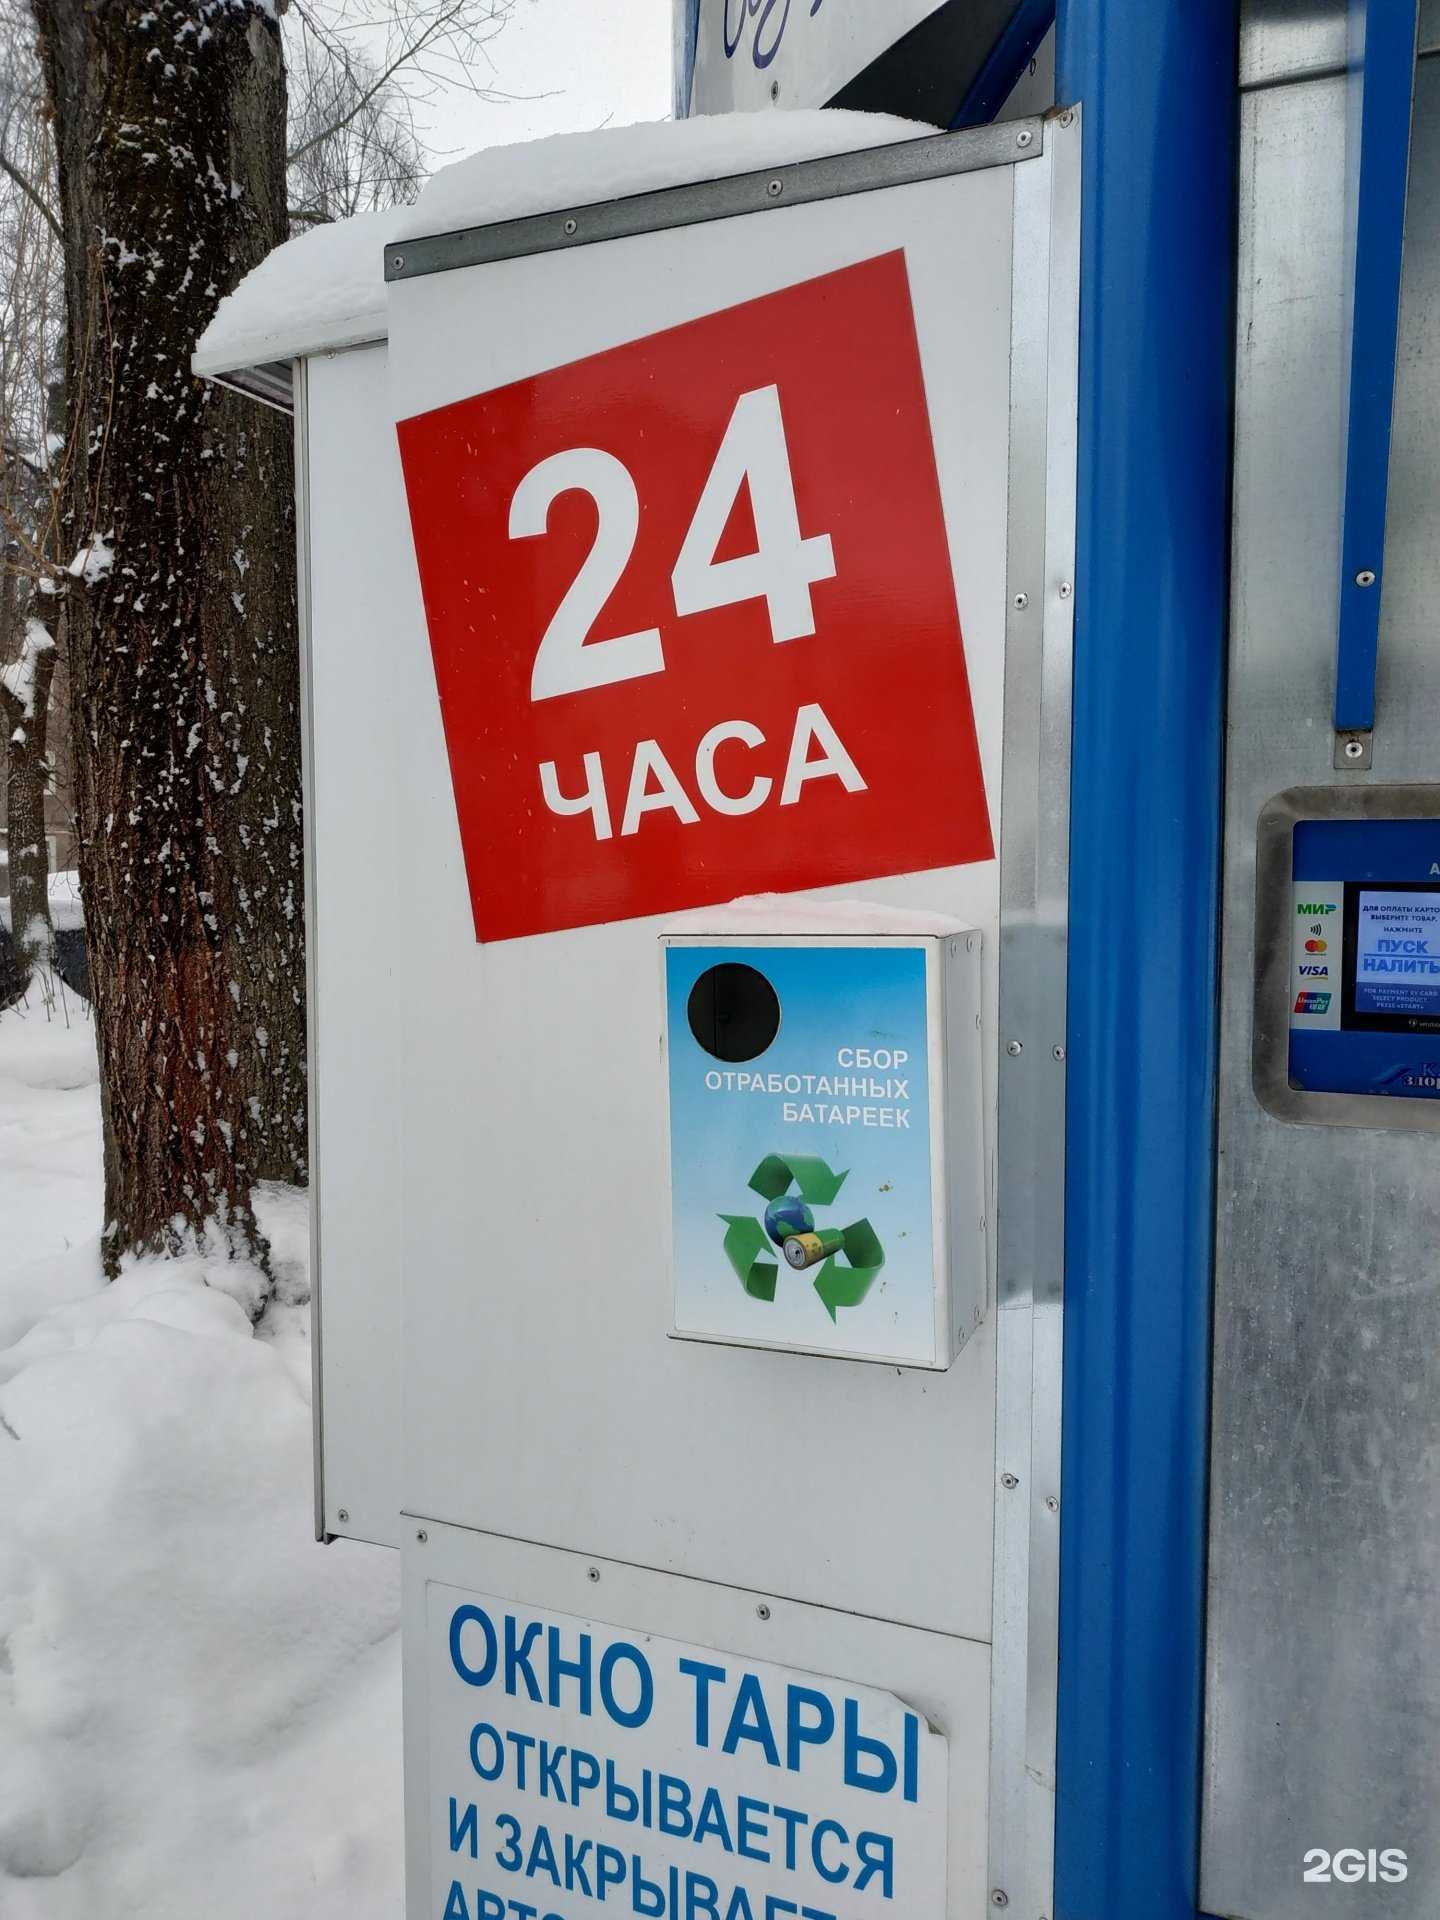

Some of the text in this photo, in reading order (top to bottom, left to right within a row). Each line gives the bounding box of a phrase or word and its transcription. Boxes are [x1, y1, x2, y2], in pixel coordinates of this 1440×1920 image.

[509, 384, 837, 702] 24
[539, 703, 868, 841] ЧАСА
[1297, 903, 1336, 915] МИР
[1380, 905, 1413, 913] ОПЛАТЫ
[1383, 926, 1423, 934] НАЖМИТЕ
[1377, 939, 1428, 954] ПУСК
[1298, 966, 1328, 976] VISA
[1363, 958, 1440, 974] НАЛИТЬ
[838, 1048, 909, 1070] СБОР
[705, 1071, 909, 1100] ОТРАБОТАННЫХ
[783, 1102, 910, 1129] БАТАРЕЕК
[449, 1604, 919, 1803] ОКНО ТАРЫ
[469, 1722, 894, 1899] ОТКРЫВАЕТСЯ
[449, 1796, 478, 1859] И
